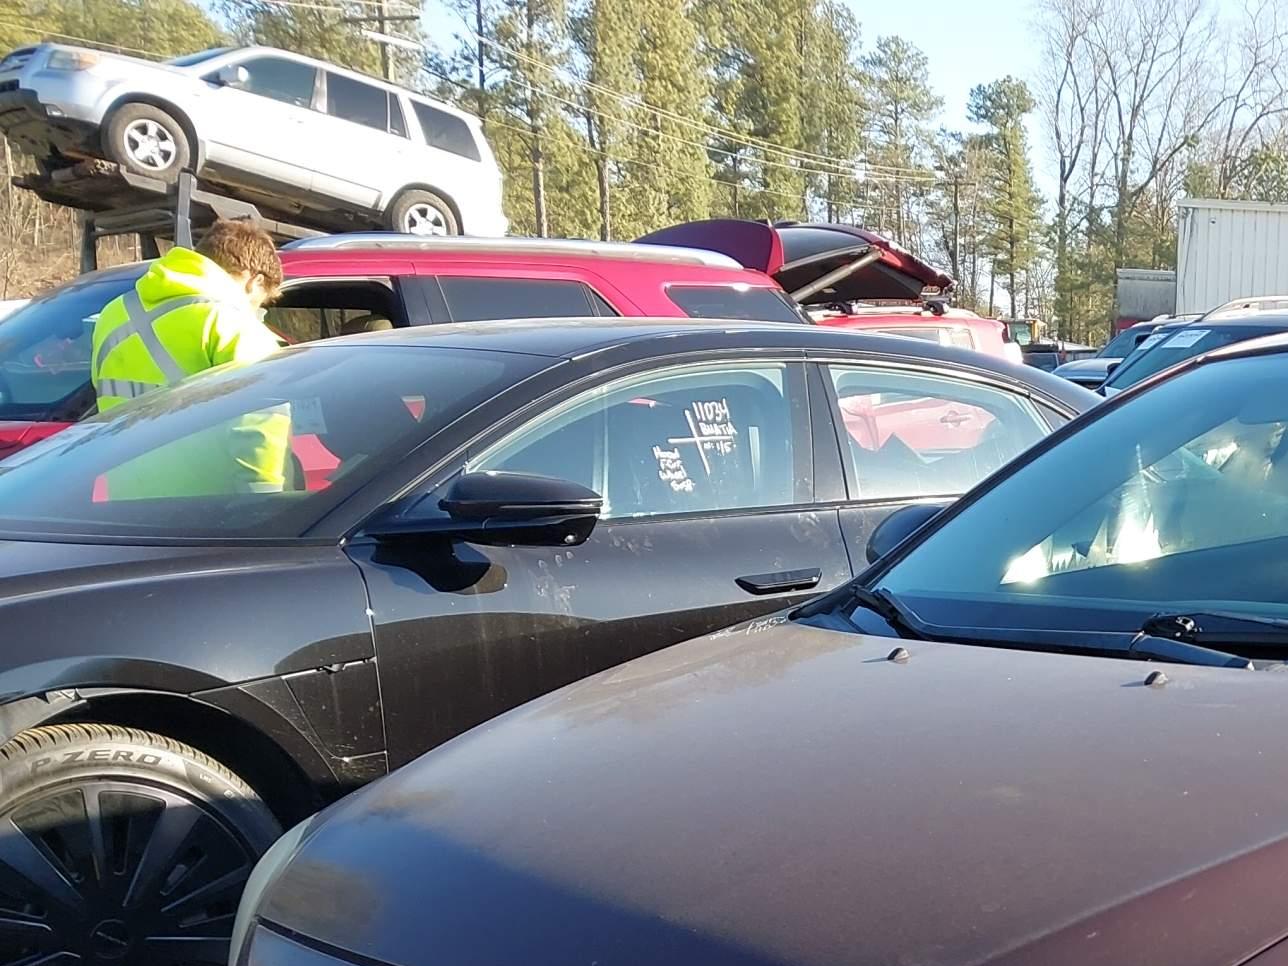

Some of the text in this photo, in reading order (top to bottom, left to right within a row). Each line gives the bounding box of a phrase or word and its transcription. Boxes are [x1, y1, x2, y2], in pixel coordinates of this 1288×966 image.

[692, 398, 730, 421] 11034
[32, 750, 162, 772] P ZERO
